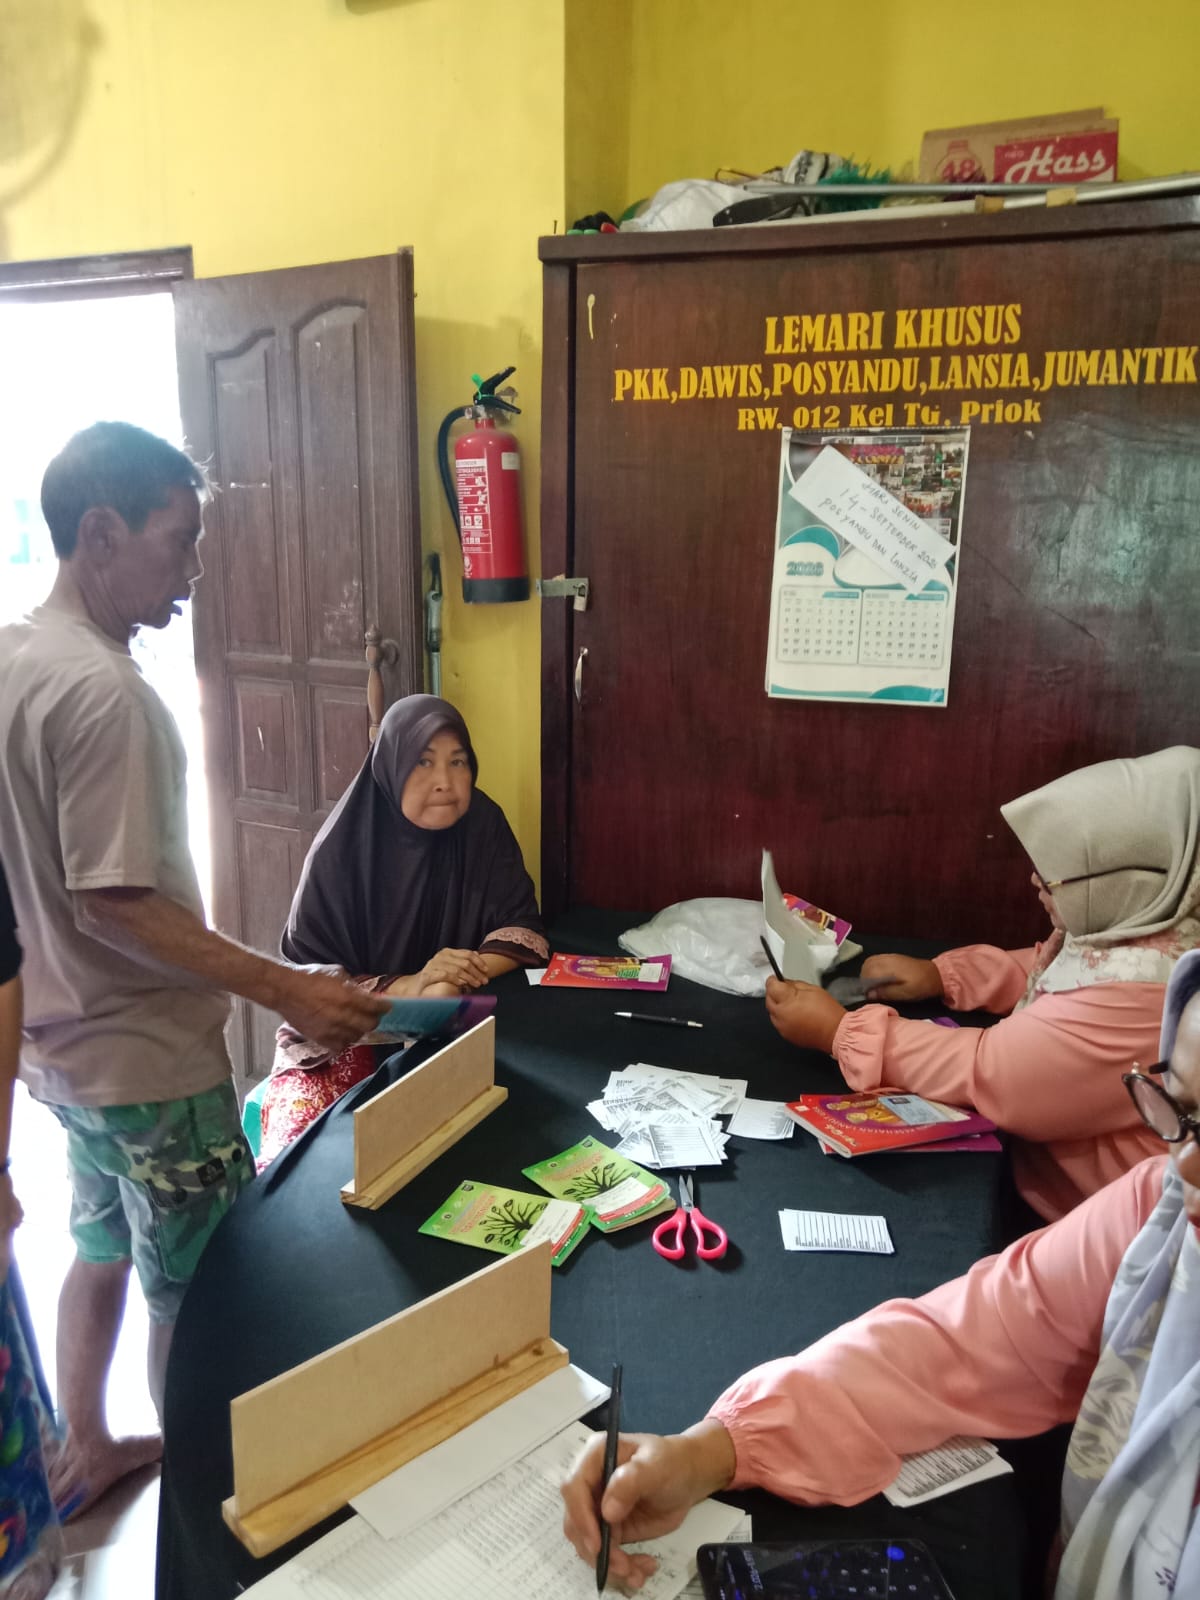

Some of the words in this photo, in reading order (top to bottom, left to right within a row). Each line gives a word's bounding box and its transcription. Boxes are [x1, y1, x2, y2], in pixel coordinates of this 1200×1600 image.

[1004, 145, 1107, 183] Hass
[764, 311, 883, 355] LEMARI
[894, 303, 1022, 349] KHUSUS
[737, 407, 784, 430] RW.
[792, 405, 841, 429] 012
[849, 403, 894, 427] Kel
[960, 398, 1042, 424] Priok
